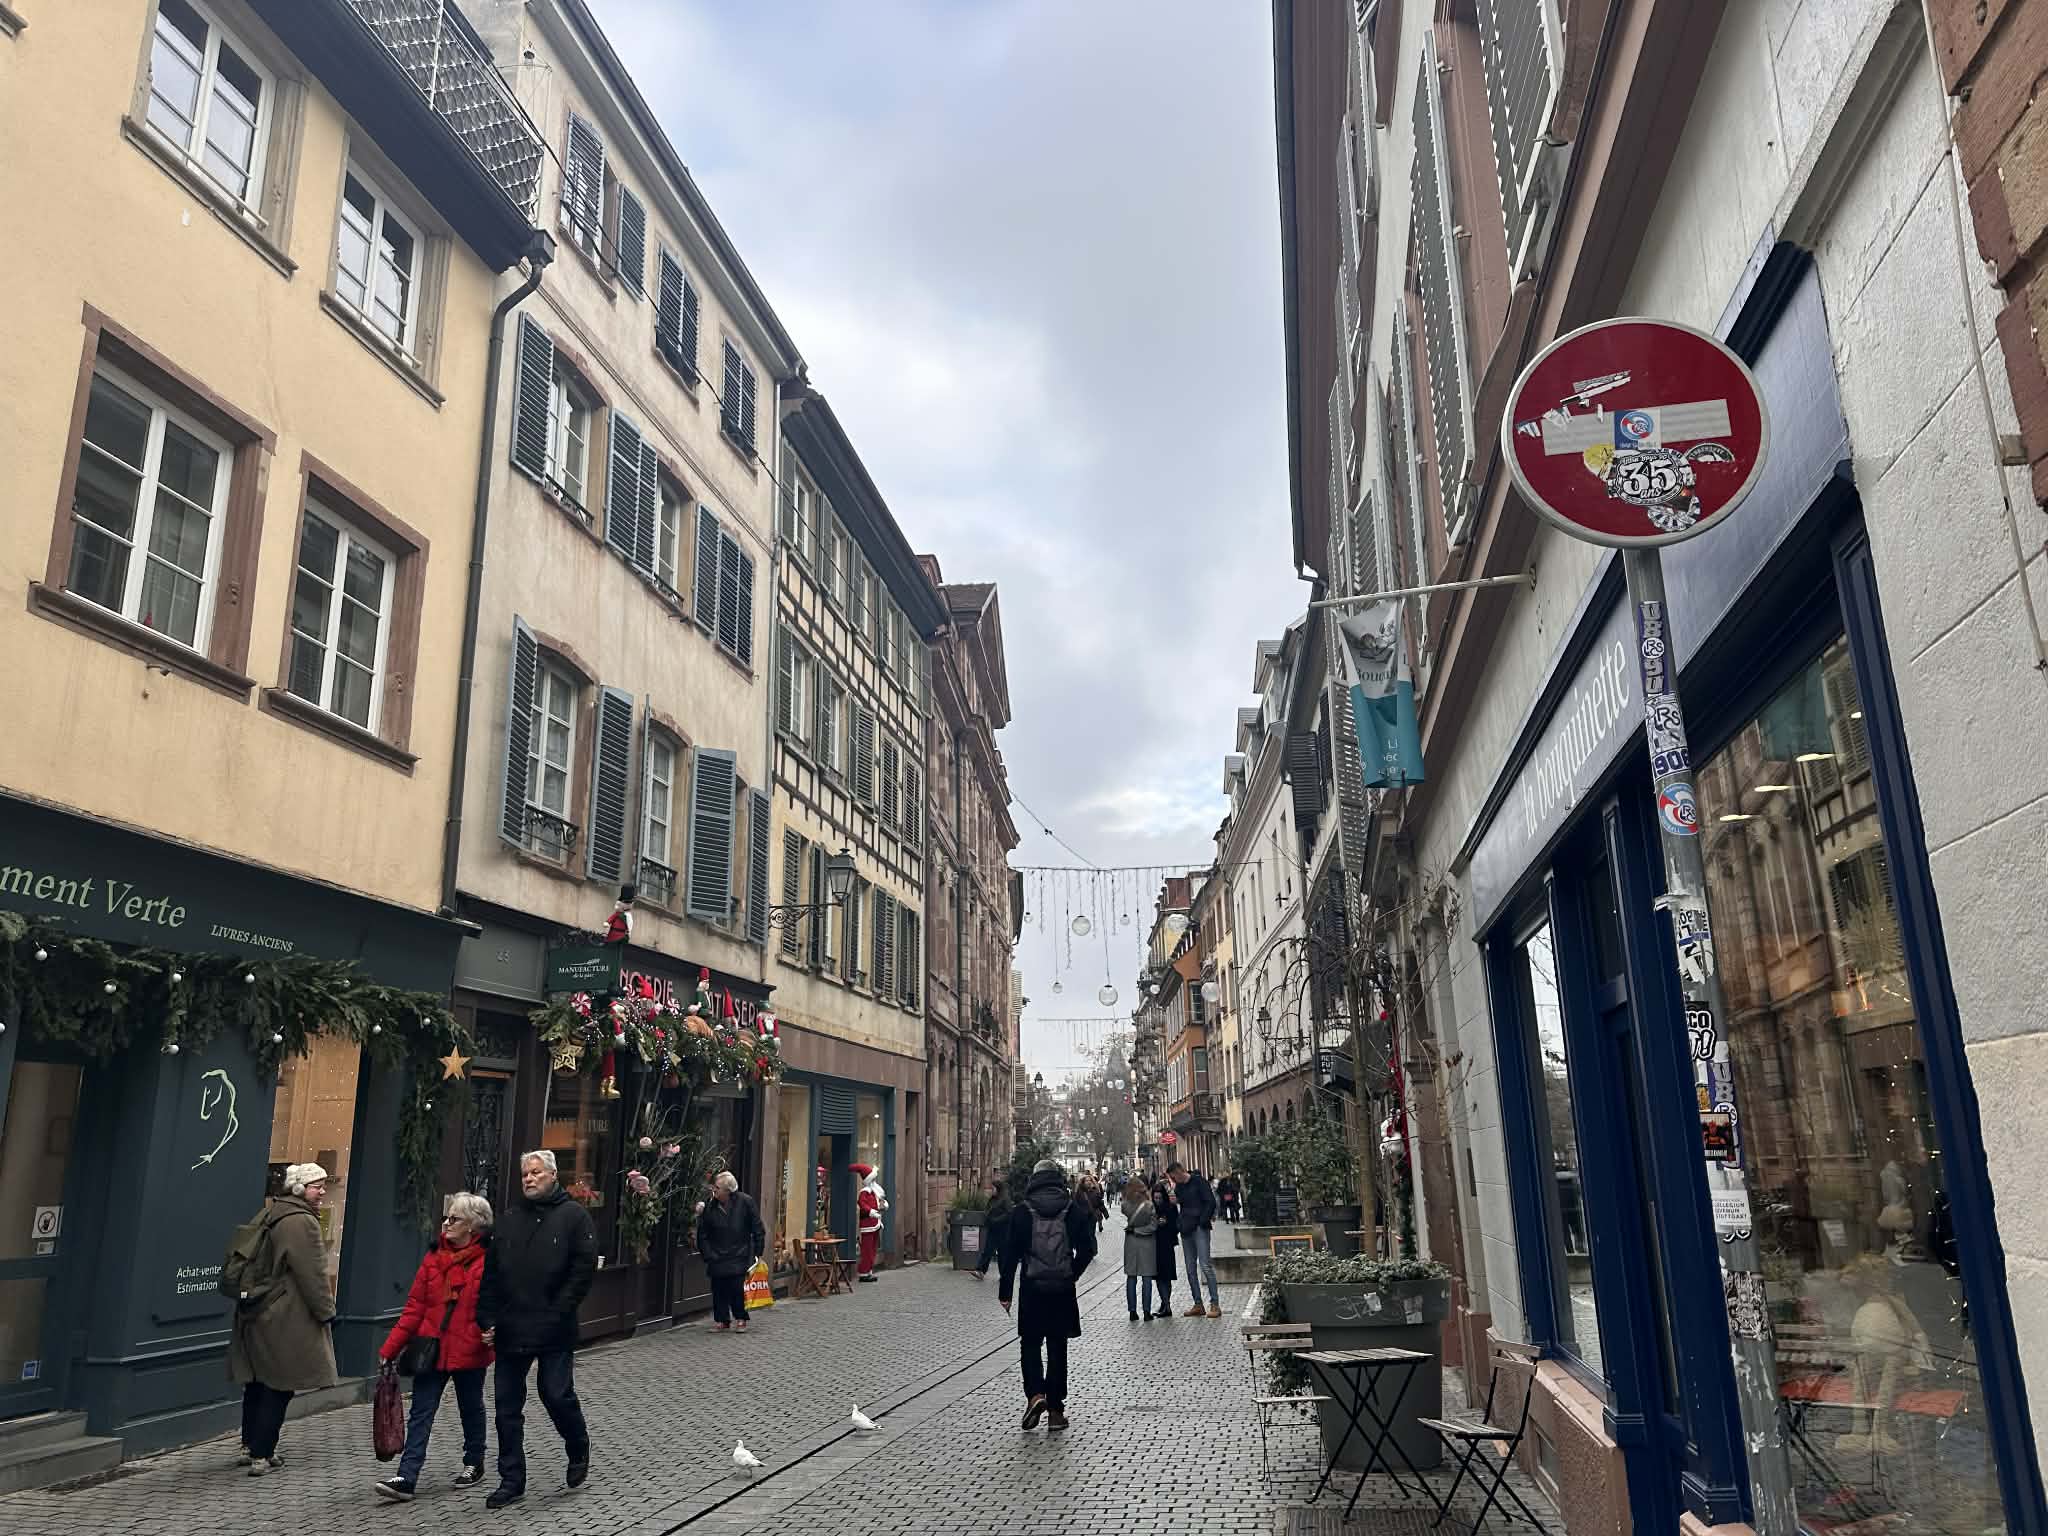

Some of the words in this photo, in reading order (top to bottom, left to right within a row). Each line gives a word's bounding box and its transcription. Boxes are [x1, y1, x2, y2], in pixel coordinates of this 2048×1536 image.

[1619, 459, 1678, 496] 35
[1640, 487, 1663, 499] ans
[1533, 639, 1631, 821] bouquinette
[0, 863, 96, 908] ment
[106, 879, 187, 928] Verte
[211, 923, 250, 945] LIVRES
[249, 932, 294, 953] ANCIENS
[176, 1265, 222, 1278] Achat-vente
[176, 1280, 218, 1294] Estimation
